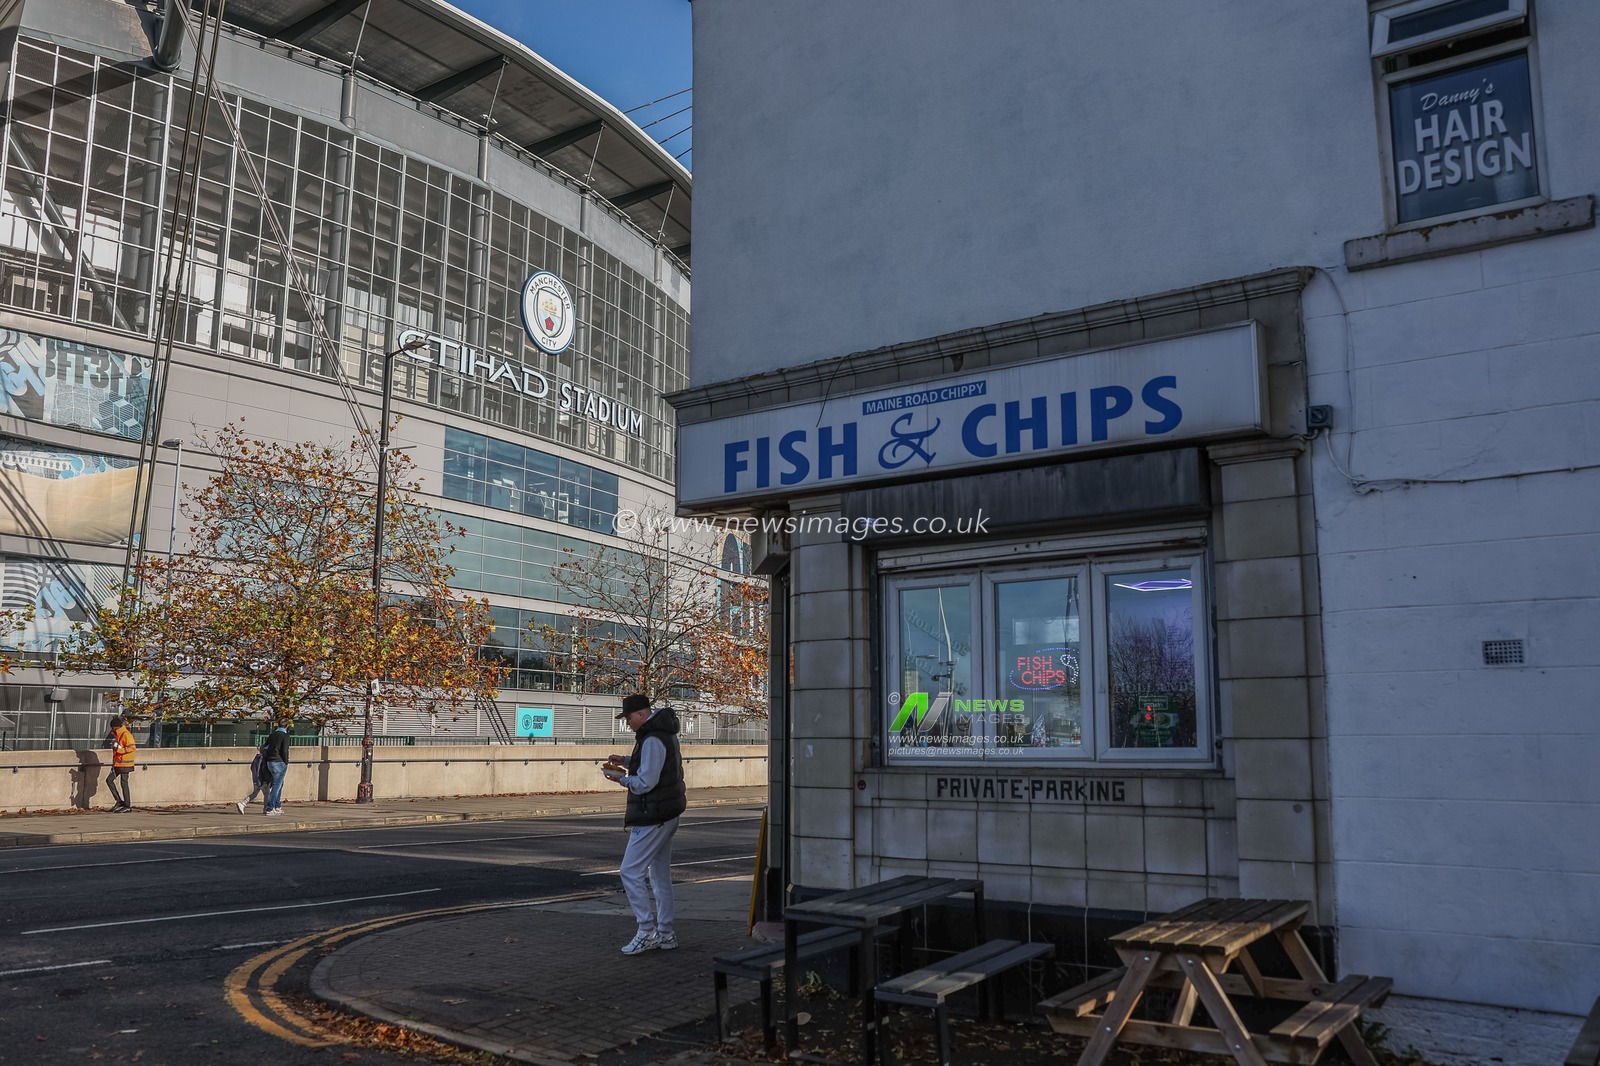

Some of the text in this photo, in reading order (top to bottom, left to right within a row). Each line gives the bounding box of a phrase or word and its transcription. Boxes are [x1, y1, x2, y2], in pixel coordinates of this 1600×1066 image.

[1420, 78, 1495, 111] Danny's
[1414, 99, 1508, 152] HAIR
[1398, 132, 1532, 195] DESIGN
[529, 276, 571, 310] MANCHESTER
[541, 336, 557, 348] CITY
[398, 329, 643, 437] ETIHAD STADIUM
[866, 382, 985, 414] MAINE ROAD CHIPPY
[724, 375, 1183, 493] FISH & CHIPS
[1017, 656, 1053, 671] FISH
[1021, 669, 1066, 685] CHIPS
[936, 777, 1125, 802] PRIVATE-PARKING
